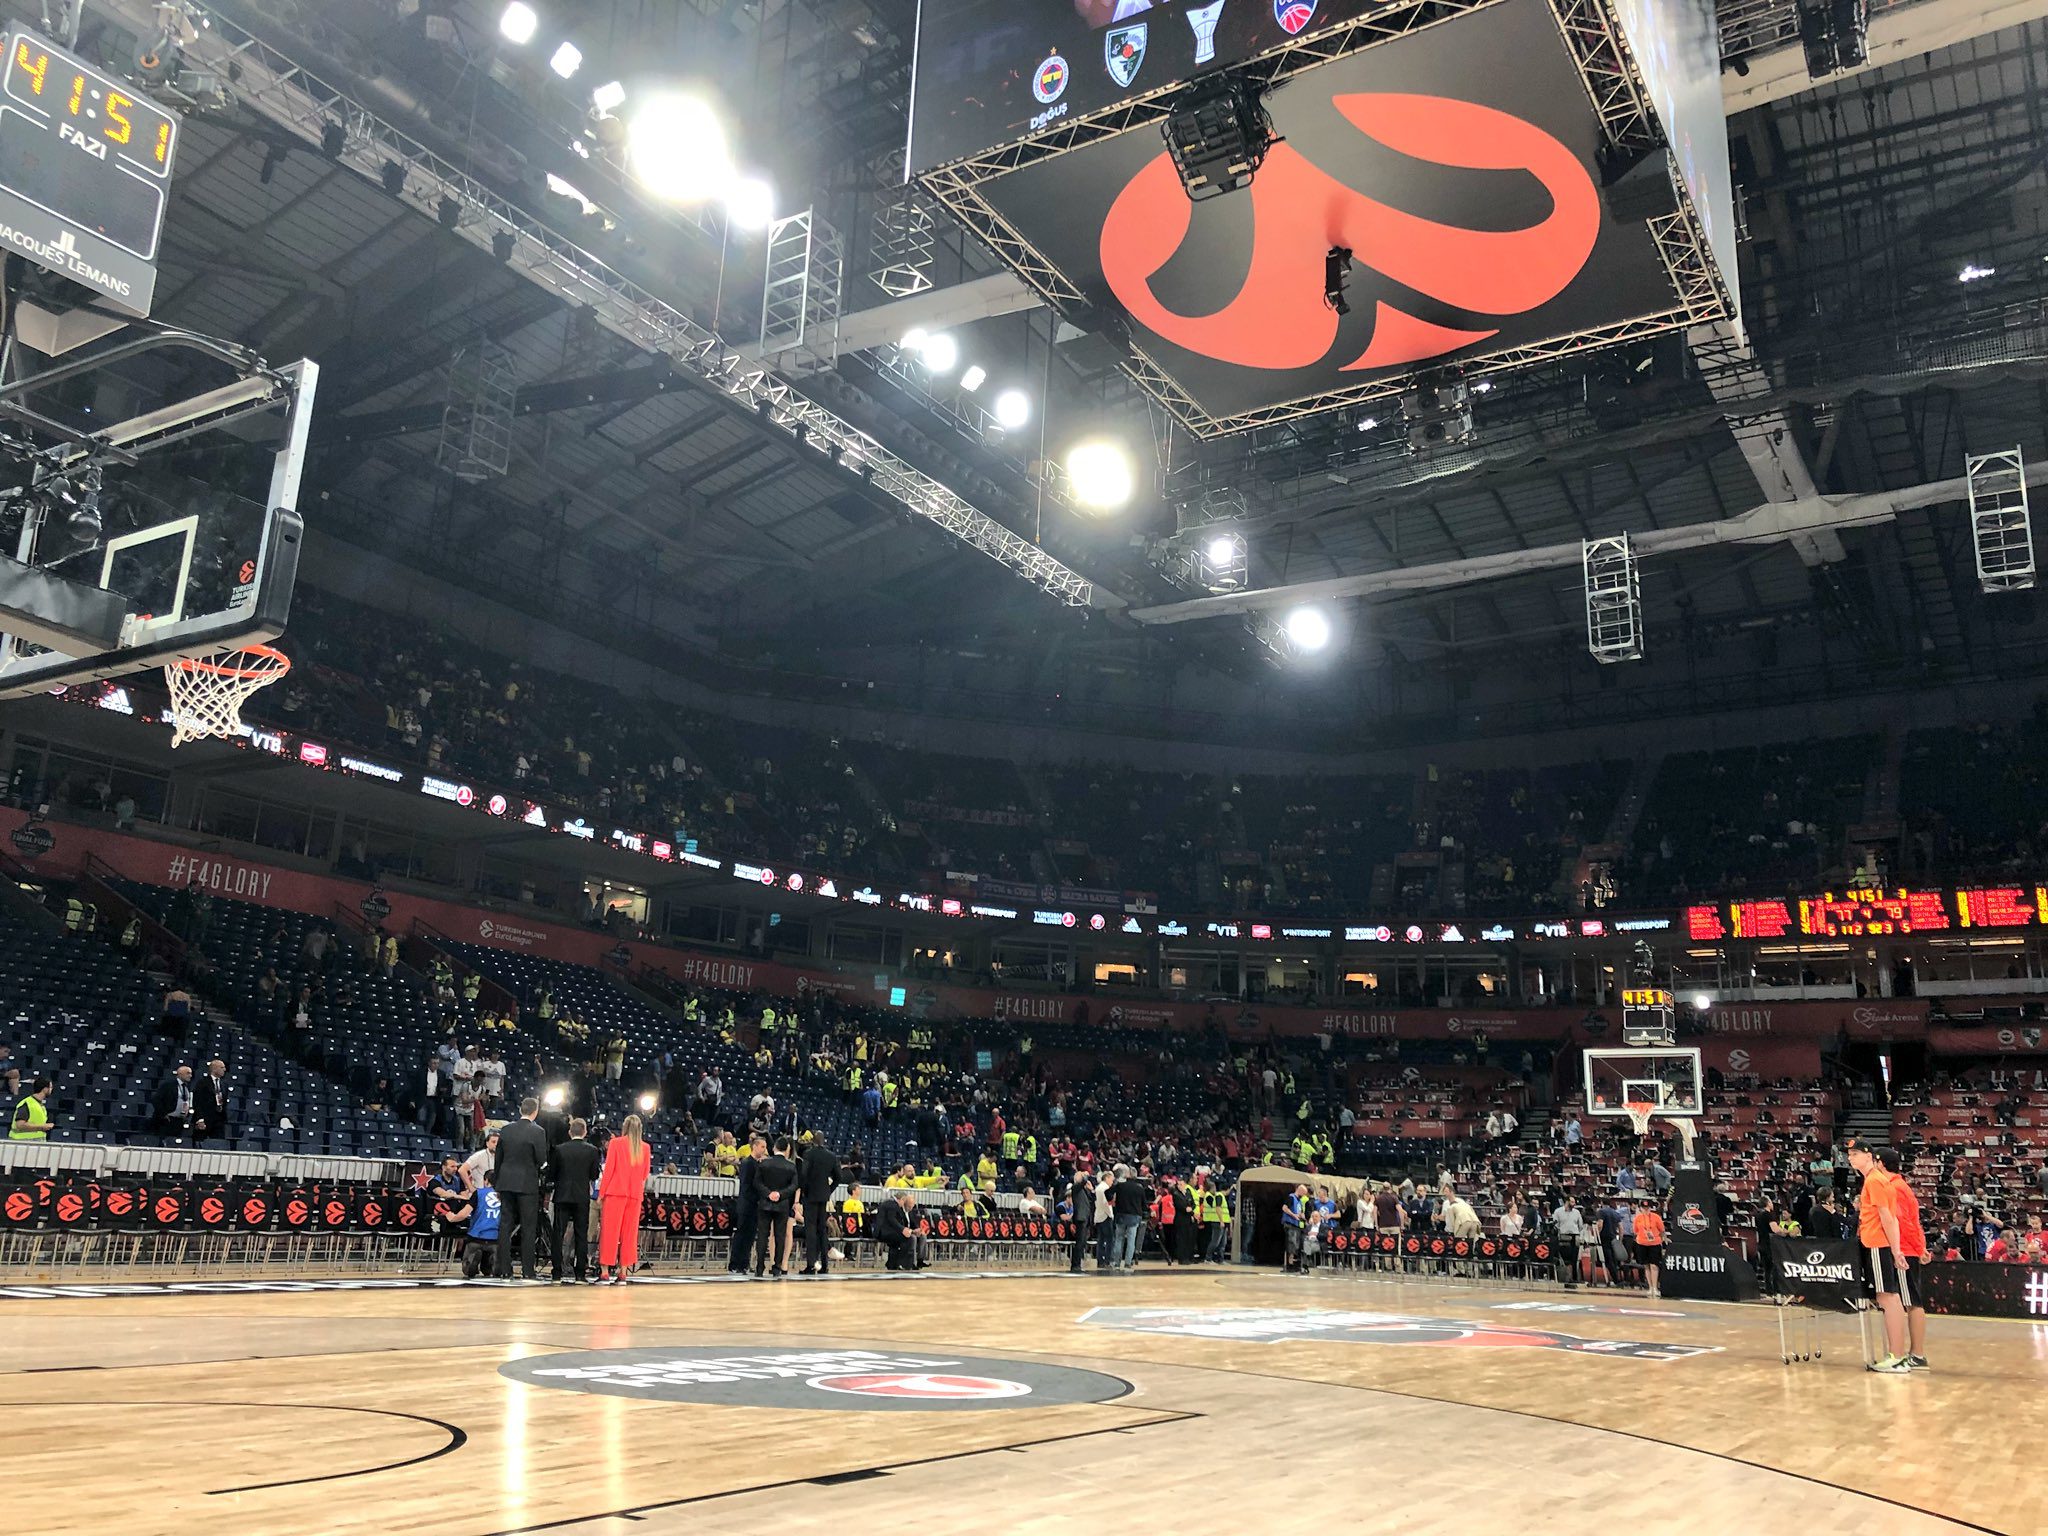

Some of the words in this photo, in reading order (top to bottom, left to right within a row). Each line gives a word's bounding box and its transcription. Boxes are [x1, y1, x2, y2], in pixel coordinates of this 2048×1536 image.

[58, 122, 108, 162] FAZI
[67, 256, 131, 297] LEMANS
[252, 732, 282, 753] VTB
[621, 834, 643, 852] VTB
[168, 854, 272, 899] #F4GLORY
[1824, 892, 1833, 904] 3
[1897, 887, 1907, 900] 3
[909, 896, 931, 911] VTB
[1033, 910, 1064, 919] TURKISH
[1837, 909, 1853, 922] 77
[1862, 908, 1872, 919] 4
[1887, 907, 1903, 919] 79
[1033, 917, 1063, 926] AIRLINES
[1902, 922, 1911, 934] 5
[495, 923, 520, 937] TURKISH
[520, 928, 547, 941] AIRLINES
[1216, 925, 1239, 938] VTB
[1544, 924, 1568, 938] VTB
[494, 931, 534, 947] EuroLeague
[683, 958, 754, 987] #F4GLORY
[994, 996, 1066, 1019] #F4GLORY
[1322, 1014, 1398, 1035] #F4GLORY
[1703, 1009, 1772, 1032] 4GLORY
[1891, 1014, 1920, 1023] Arena
[485, 1208, 501, 1218] TV
[1665, 1255, 1726, 1273] #F4GLORY
[1782, 1260, 1855, 1281] SPALDING
